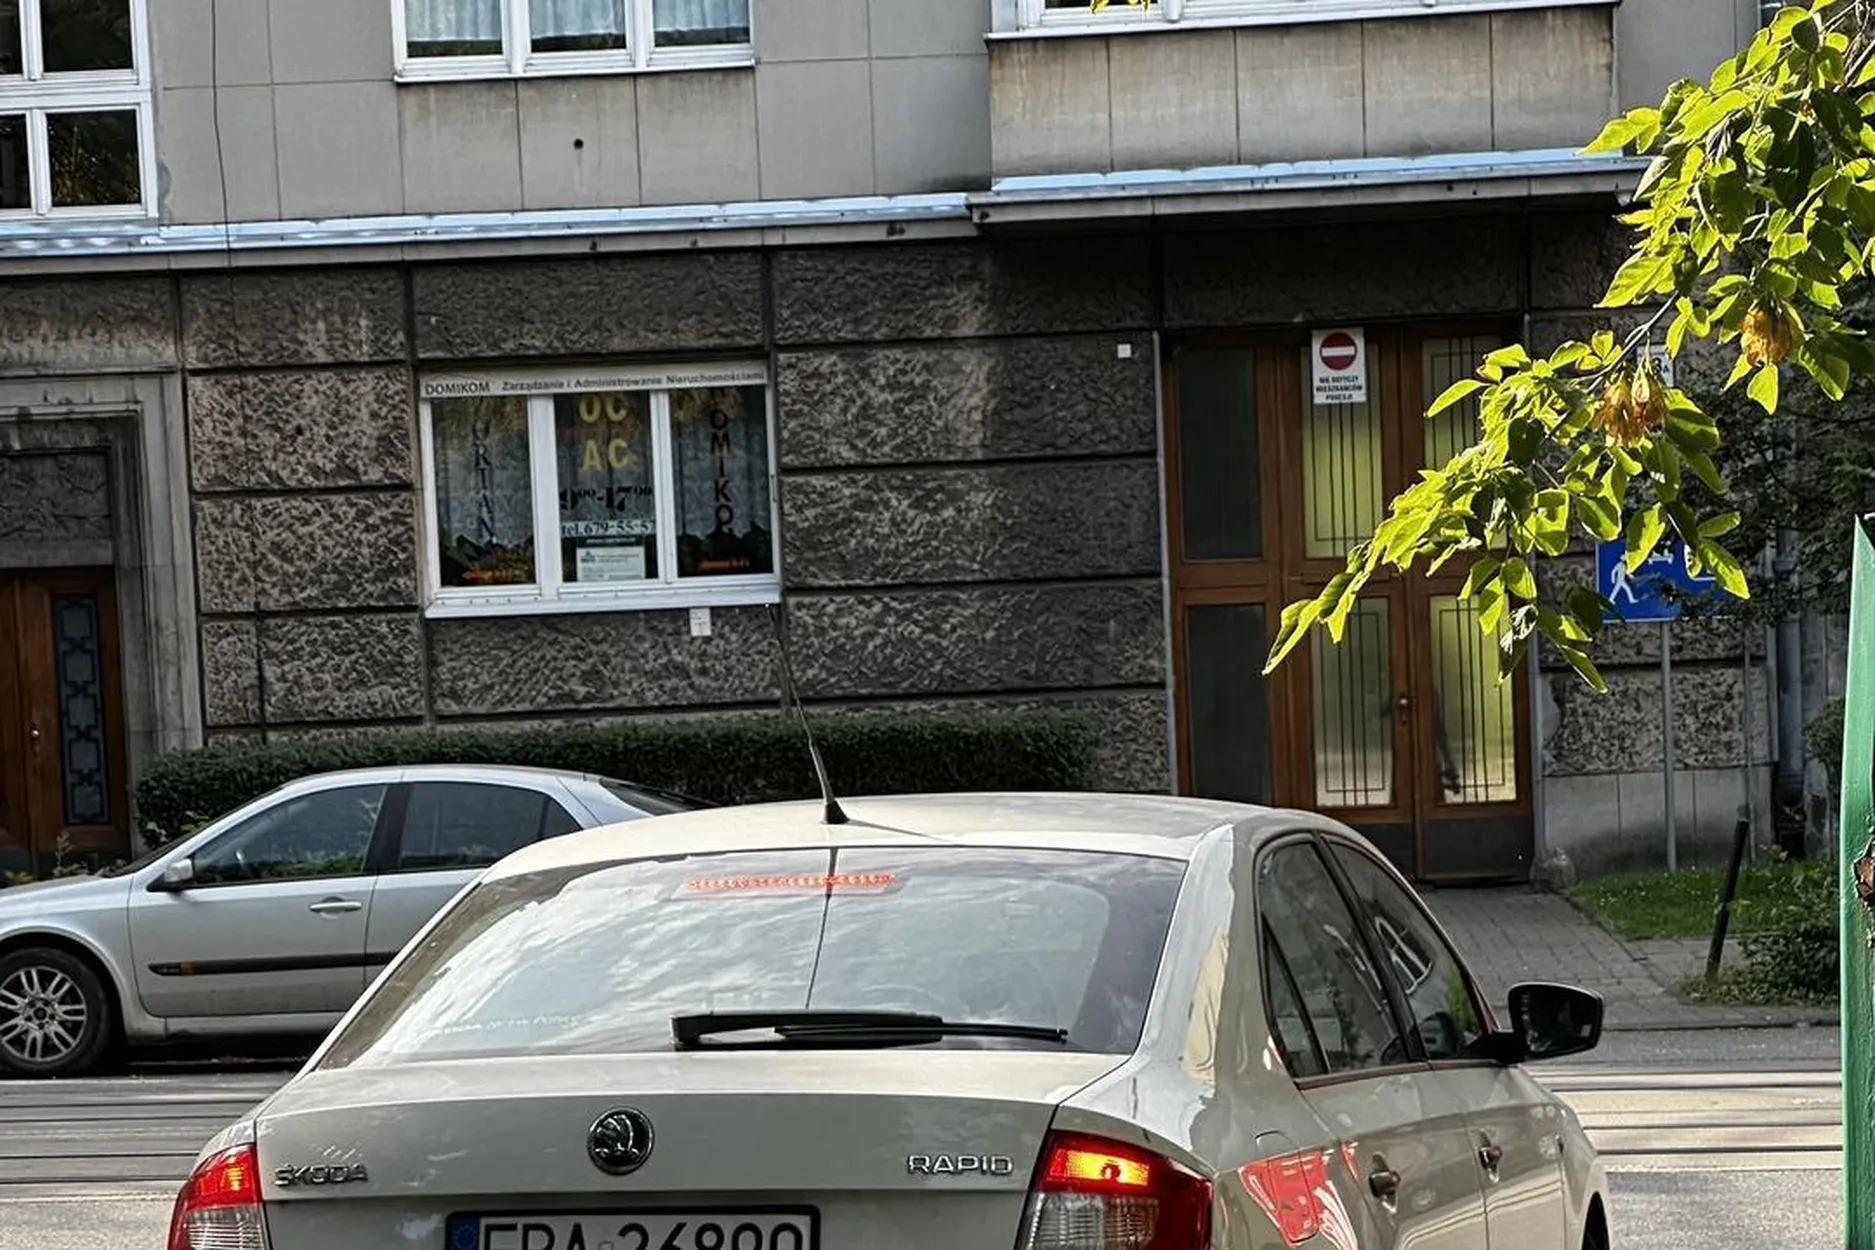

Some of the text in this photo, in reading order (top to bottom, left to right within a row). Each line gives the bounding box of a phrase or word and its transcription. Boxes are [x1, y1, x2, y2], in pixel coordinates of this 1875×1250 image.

[424, 381, 491, 396] DOMIKOM
[582, 438, 629, 472] AC
[907, 1154, 1014, 1176] RAPID
